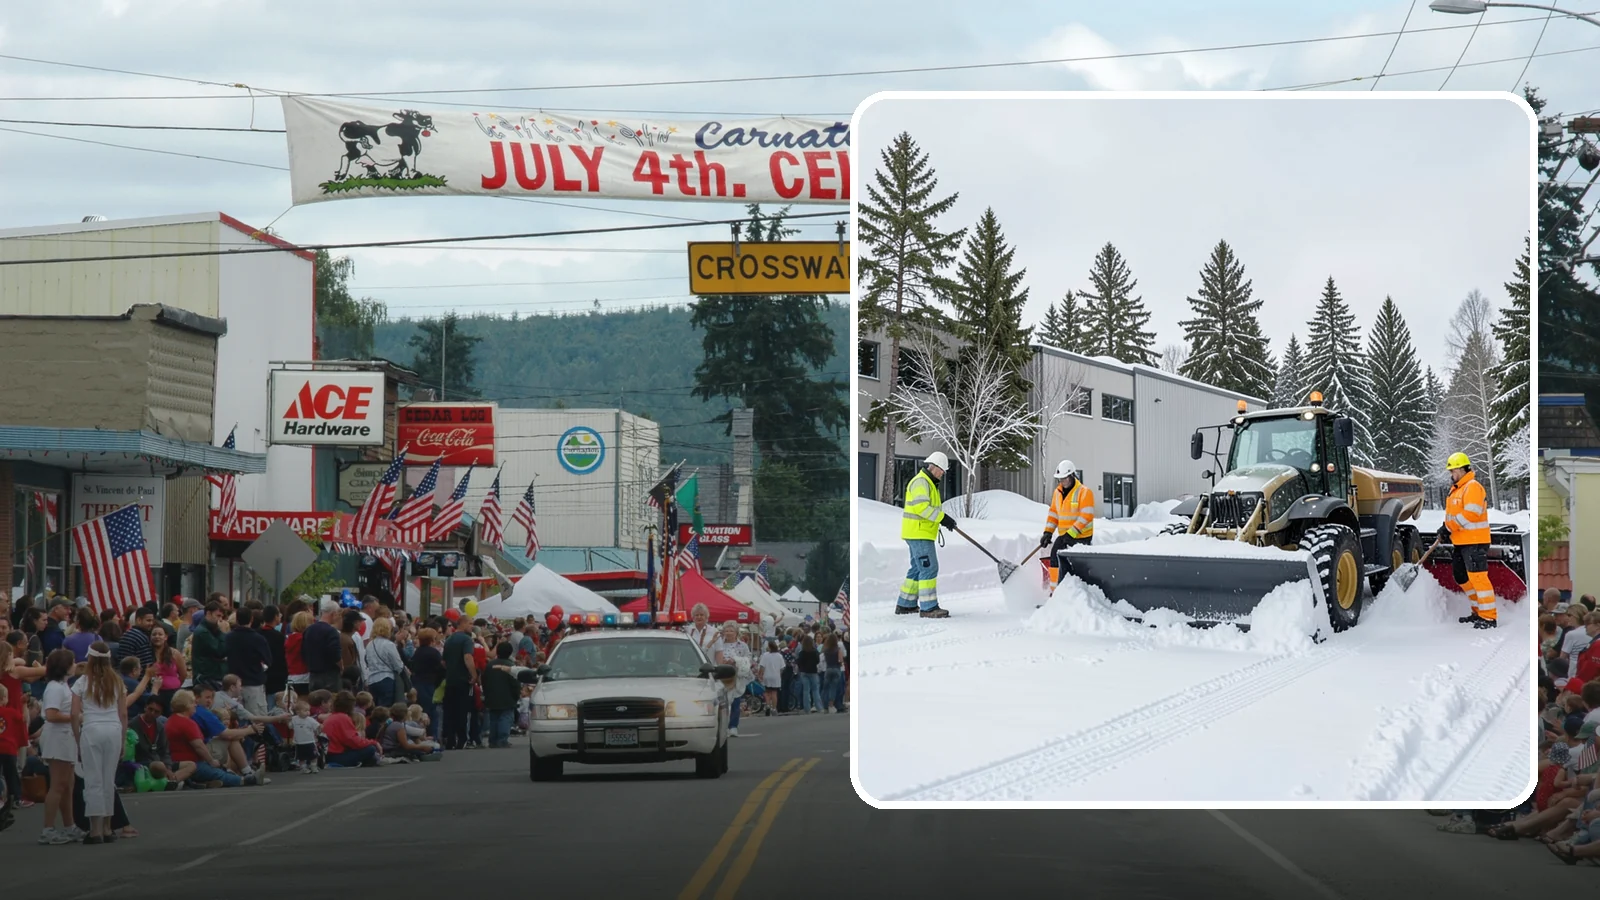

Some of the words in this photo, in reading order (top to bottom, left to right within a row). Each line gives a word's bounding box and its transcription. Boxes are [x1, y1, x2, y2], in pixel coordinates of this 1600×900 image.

[695, 121, 850, 149] Carnat
[481, 141, 605, 193] JULY
[632, 150, 746, 198] 4th.
[697, 255, 850, 280] CROSSWA
[283, 380, 373, 420] ACE
[406, 409, 452, 421] CEDAR
[461, 409, 485, 421] LOG
[283, 421, 370, 436] Hardware
[416, 428, 477, 447] Coca-Cola
[95, 485, 124, 494] Vincent
[126, 486, 136, 495] de
[137, 486, 155, 495] Paul
[688, 526, 741, 535] CRNATION
[699, 535, 730, 543] GLASS
